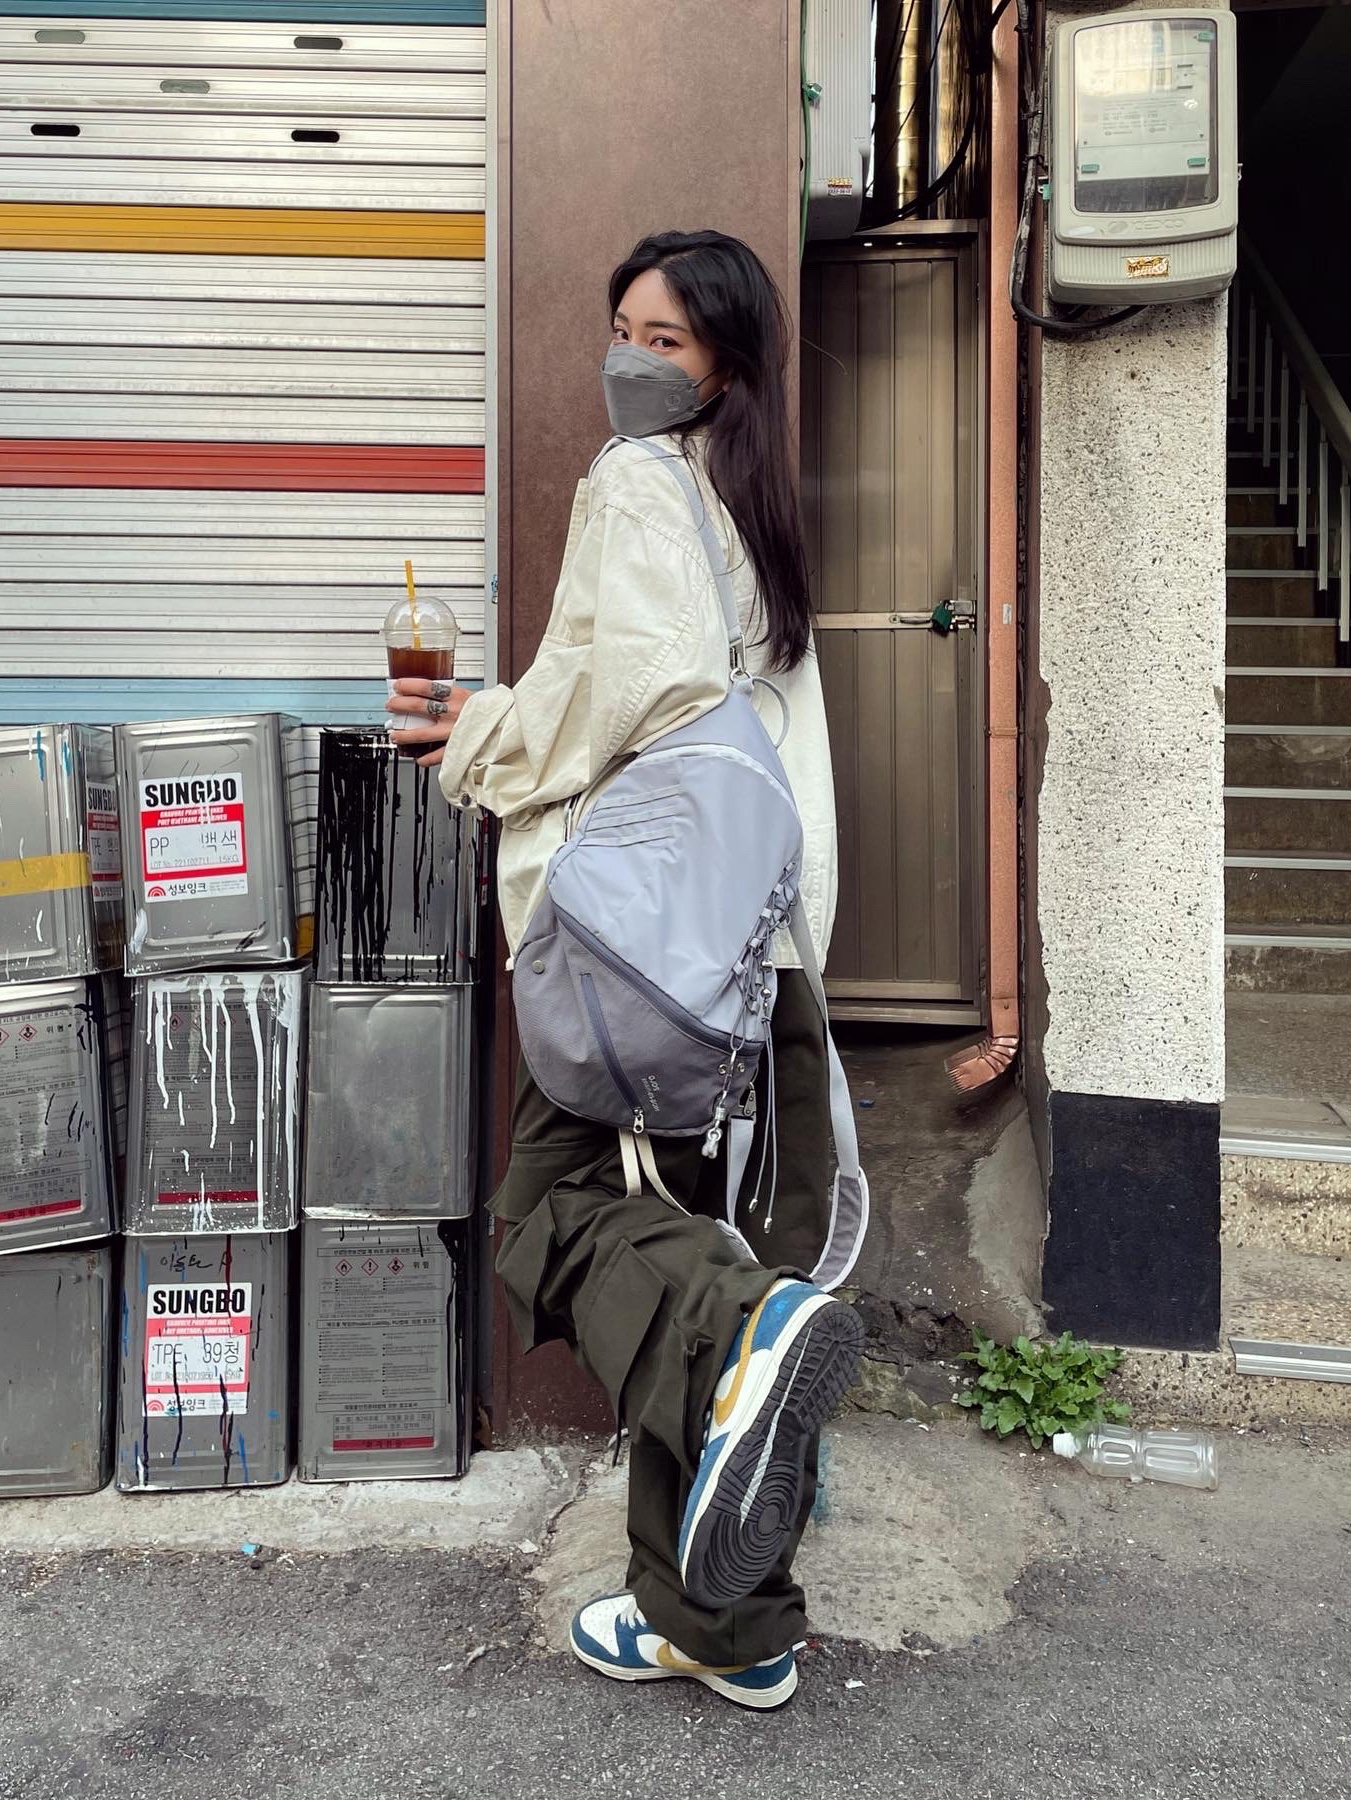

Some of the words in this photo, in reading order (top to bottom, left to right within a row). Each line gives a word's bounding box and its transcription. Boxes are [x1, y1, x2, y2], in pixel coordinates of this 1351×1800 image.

[145, 778, 237, 807] SUNGBO
[150, 837, 169, 856] PP
[168, 882, 207, 896] 성보잉크
[153, 1288, 246, 1315] SUNGBO
[153, 1343, 183, 1364] TPE
